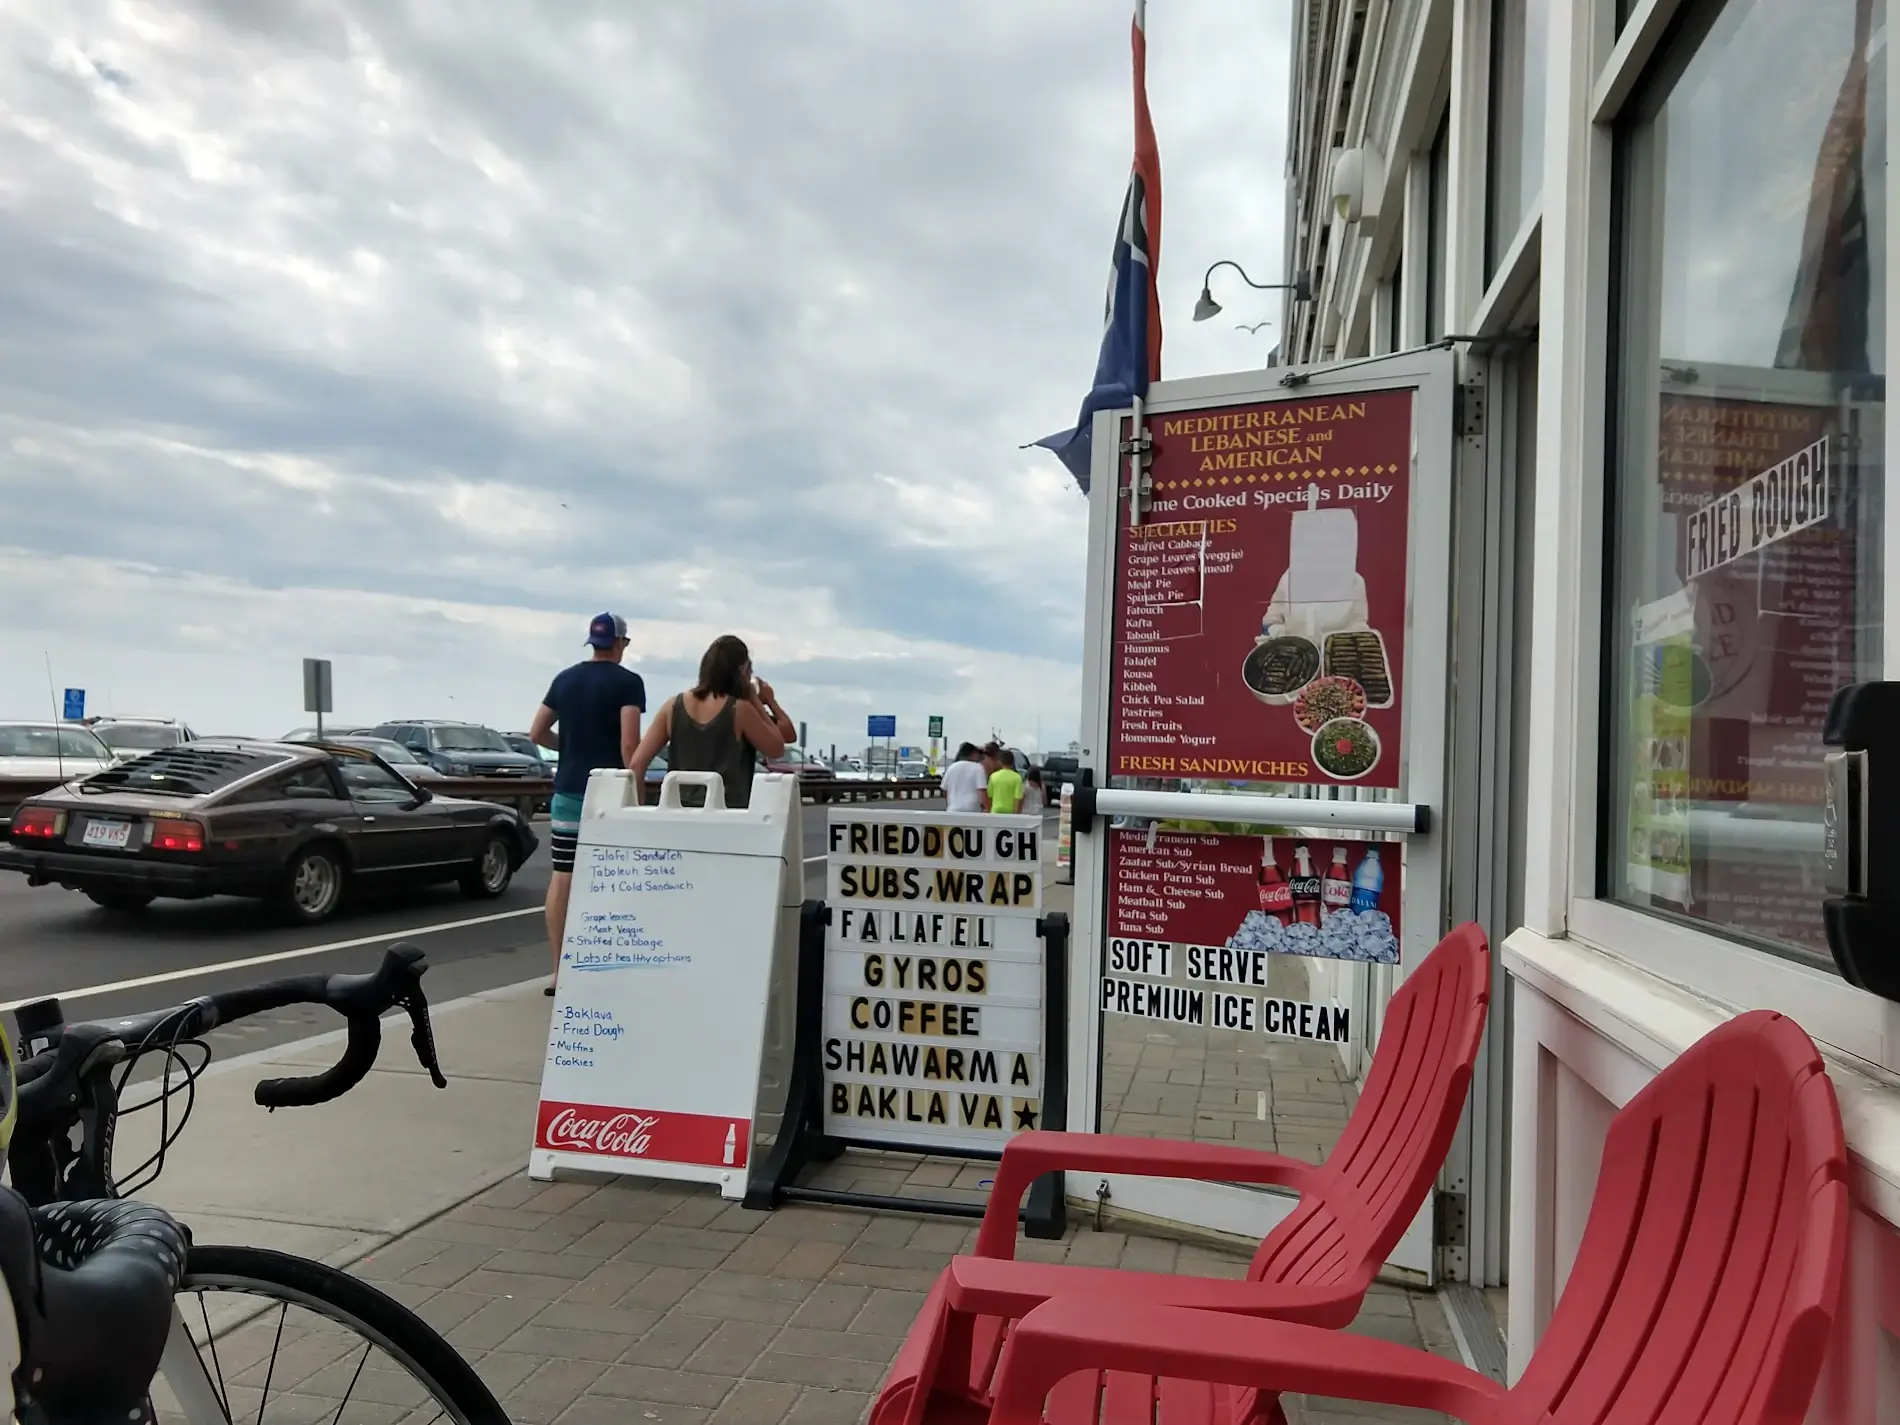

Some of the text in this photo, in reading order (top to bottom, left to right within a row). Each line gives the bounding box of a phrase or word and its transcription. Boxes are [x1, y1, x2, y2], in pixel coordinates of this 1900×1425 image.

[1164, 402, 1366, 436] MEDITERRANEAN
[1191, 428, 1333, 452] LEBANESE and
[1199, 446, 1323, 471] AMERICAN
[1183, 491, 1247, 510] Cooked
[1338, 481, 1393, 503] Daily
[1688, 493, 1741, 576] FRIED
[1752, 437, 1827, 547] DOUGH
[1129, 541, 1164, 551] Stuffed
[1128, 554, 1159, 566] Grape
[1162, 552, 1196, 563] Leaves
[1128, 566, 1157, 578] Grape
[1161, 565, 1195, 576] Leaves
[1127, 579, 1172, 590] Meat Pie
[1127, 590, 1184, 604] Spinach Pie
[1126, 605, 1163, 615] Fatouch
[1126, 618, 1153, 628] Kafta
[1126, 630, 1160, 640] Tabouli
[1124, 644, 1170, 654] Hummus
[1124, 656, 1157, 667] Falafel
[1123, 669, 1153, 679] Kousa
[1123, 681, 1157, 692] Kibbeh
[1121, 694, 1205, 705] Chick Pea Salad
[1122, 708, 1163, 718] Pastries
[1121, 720, 1183, 731] Fresh Fruits
[1120, 733, 1217, 746] Homemade Yogurt
[1120, 755, 1309, 777] FRESH SANDWICHES
[1119, 831, 1220, 846] Meditrranean Sub
[1119, 843, 1192, 857] American Sub
[1220, 863, 1253, 874] Bread
[1118, 869, 1215, 885] Chicken Parm Sub
[619, 881, 642, 892] Cold
[645, 880, 694, 892] Sandwich
[1119, 882, 1225, 899] Ham & Cheese Sub
[1118, 895, 1186, 909] Meatball Sub
[1118, 908, 1168, 921] Kafta Sub
[841, 910, 992, 947] FALAFEL
[1118, 921, 1164, 934] Tuna Sub
[616, 936, 664, 951] Cabbage
[576, 951, 600, 964] Lots
[602, 952, 613, 962] of
[1112, 939, 1266, 985] SOFT SERVE
[864, 954, 985, 993] GYROS
[564, 1006, 612, 1020] Baklava
[851, 997, 979, 1036] COFFEE
[1102, 978, 1350, 1043] PREMIUM ICE CREAM
[563, 1022, 624, 1041] Fried Dough
[557, 1040, 594, 1053] Muffins
[555, 1055, 594, 1067] Cookies
[825, 1039, 1029, 1085] SHAWARMA
[832, 1083, 1002, 1128] BAKLAVA
